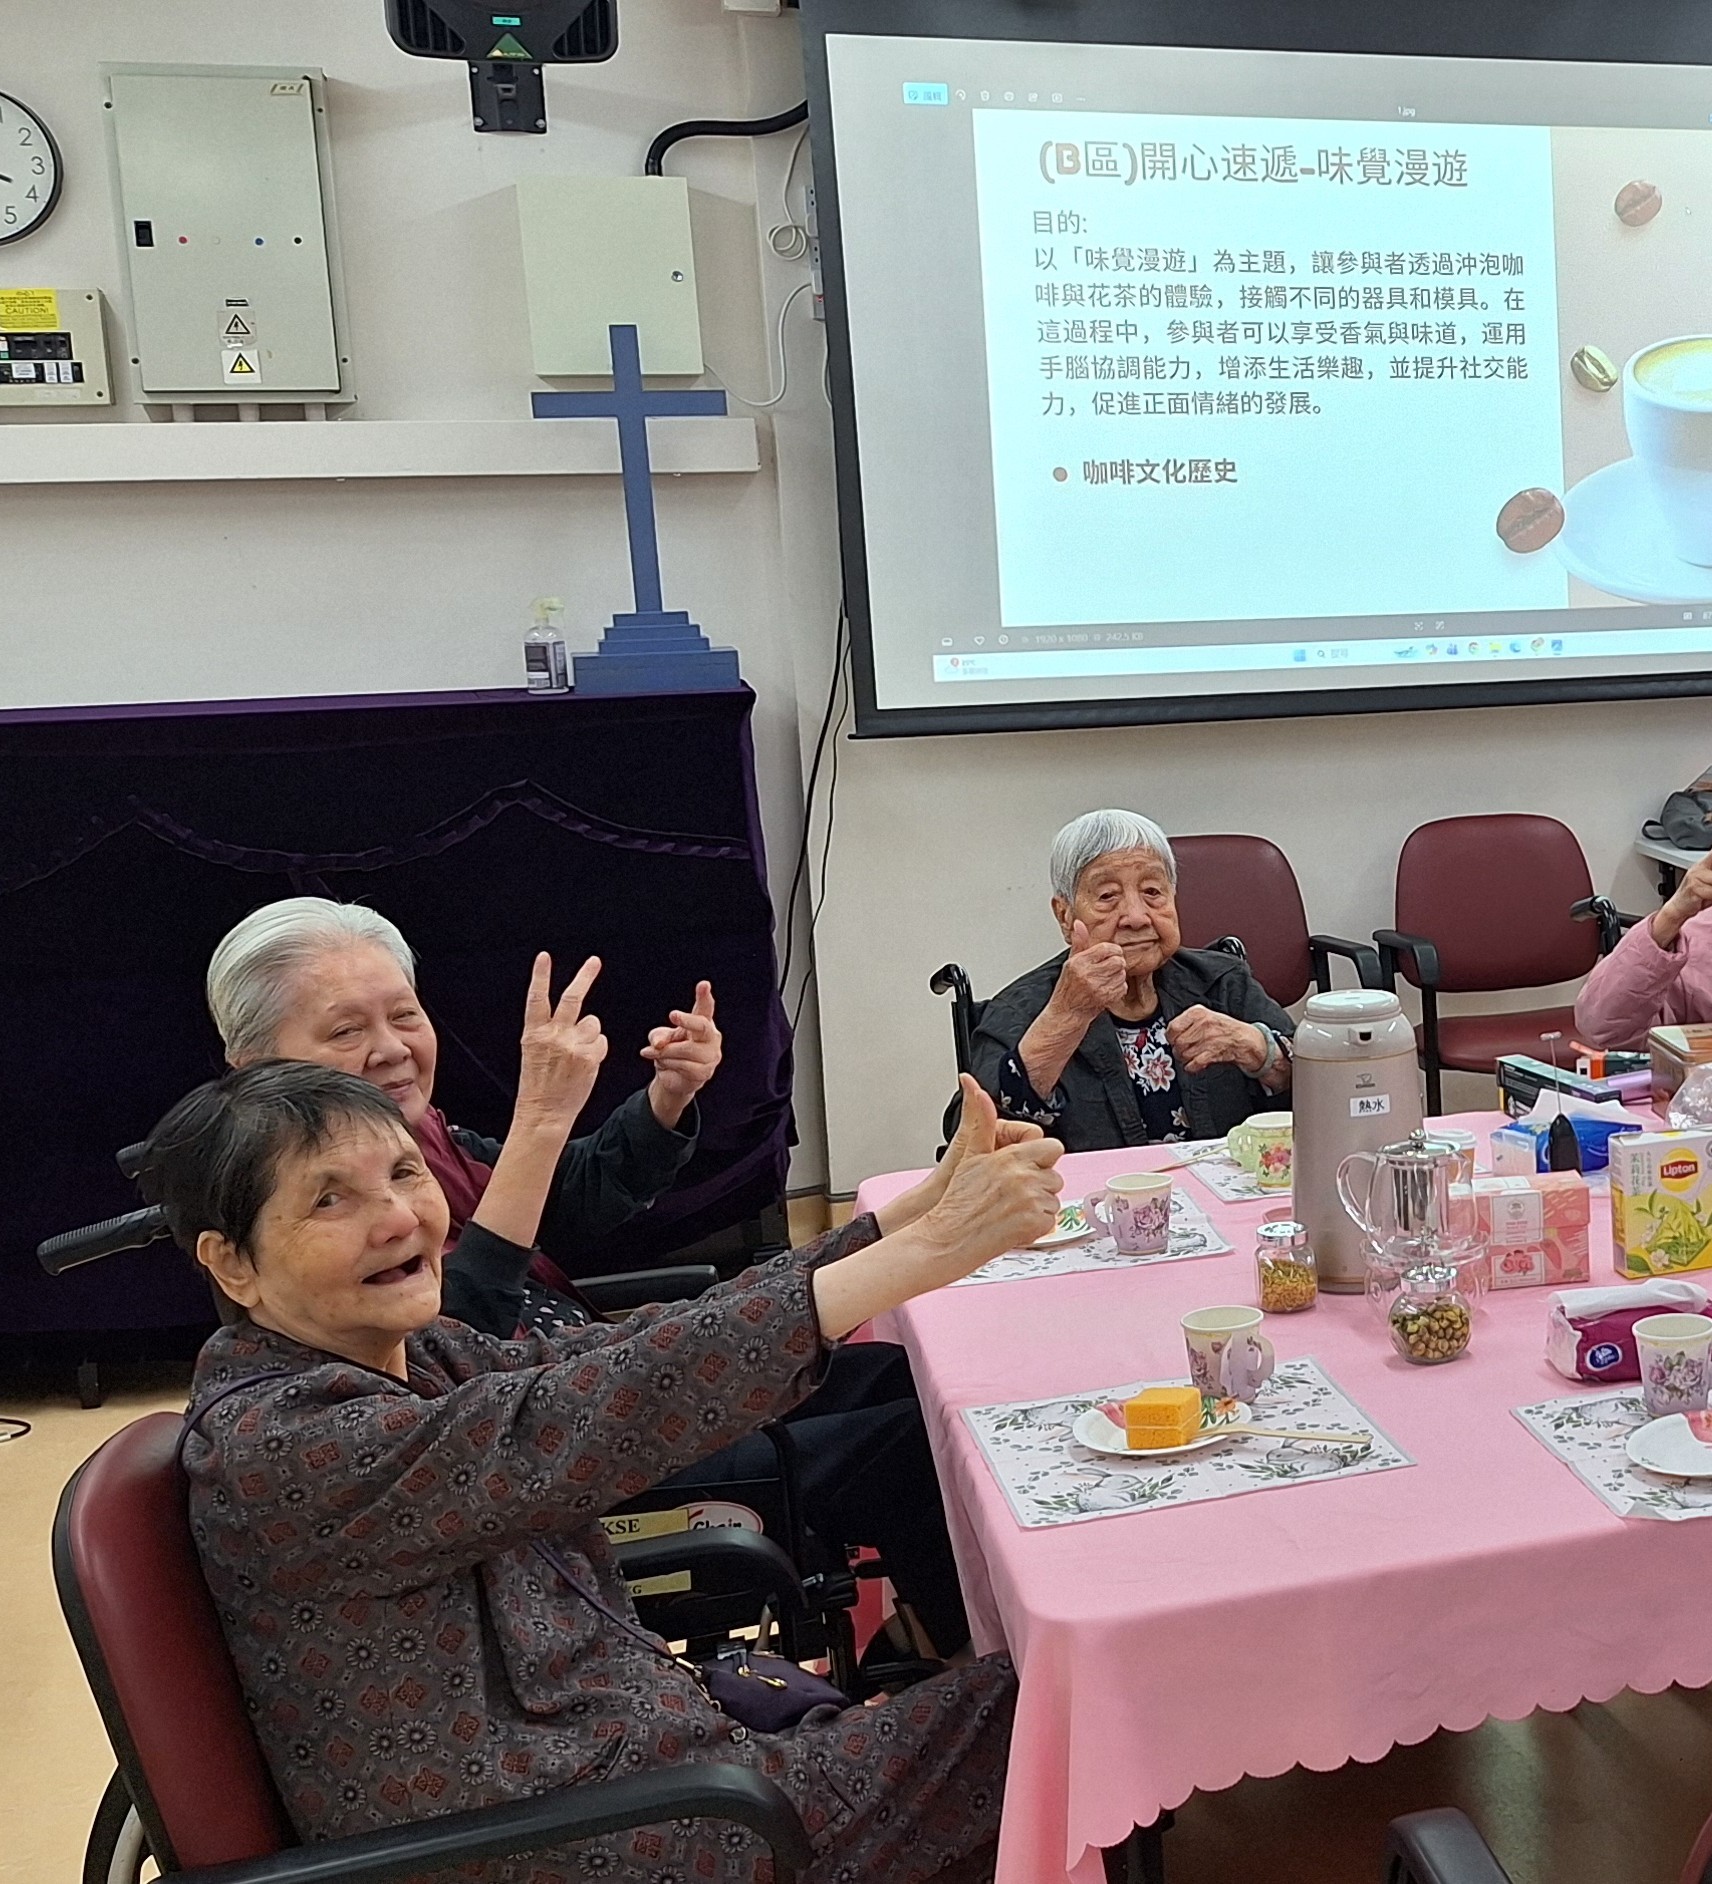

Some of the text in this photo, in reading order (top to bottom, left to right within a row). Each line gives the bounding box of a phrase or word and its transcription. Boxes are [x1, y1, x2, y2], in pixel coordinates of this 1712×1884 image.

[18, 127, 33, 146] 2
[31, 156, 45, 175] 3
[1039, 140, 1468, 187] (B區)開心速遞-味覺漫遊
[25, 184, 39, 203] 4
[4, 206, 17, 224] 5
[1033, 209, 1088, 235] 目的:
[5, 307, 49, 315] CAUTION!
[1041, 390, 1322, 416] 力，促進正面情緒的發展。
[1082, 457, 1239, 485] 咖啡文化歷史
[1359, 1098, 1385, 1113] 熱水
[1663, 1165, 1696, 1178] Lipton
